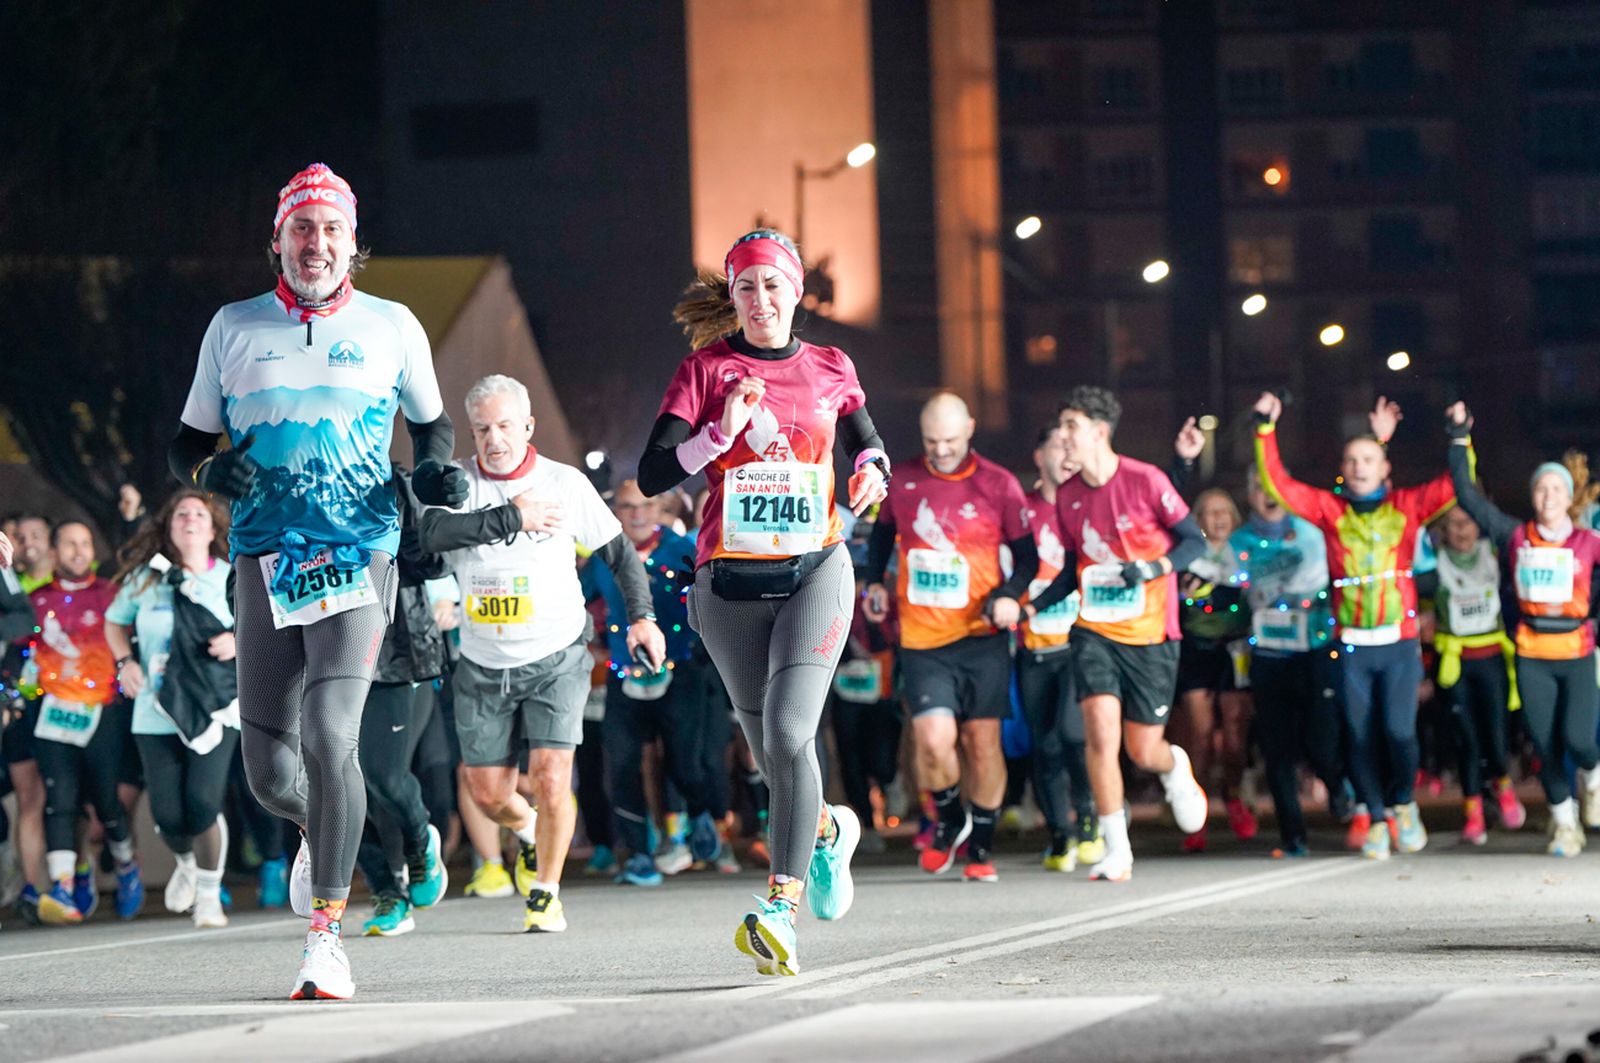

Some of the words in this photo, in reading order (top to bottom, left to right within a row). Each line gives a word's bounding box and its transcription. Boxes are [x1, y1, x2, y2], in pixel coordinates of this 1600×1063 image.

[748, 472, 778, 482] NOCHE
[780, 472, 791, 482] DE
[735, 484, 756, 494] SAN
[758, 484, 791, 494] ANTON
[739, 495, 812, 524] 12146
[478, 597, 520, 617] 5017
